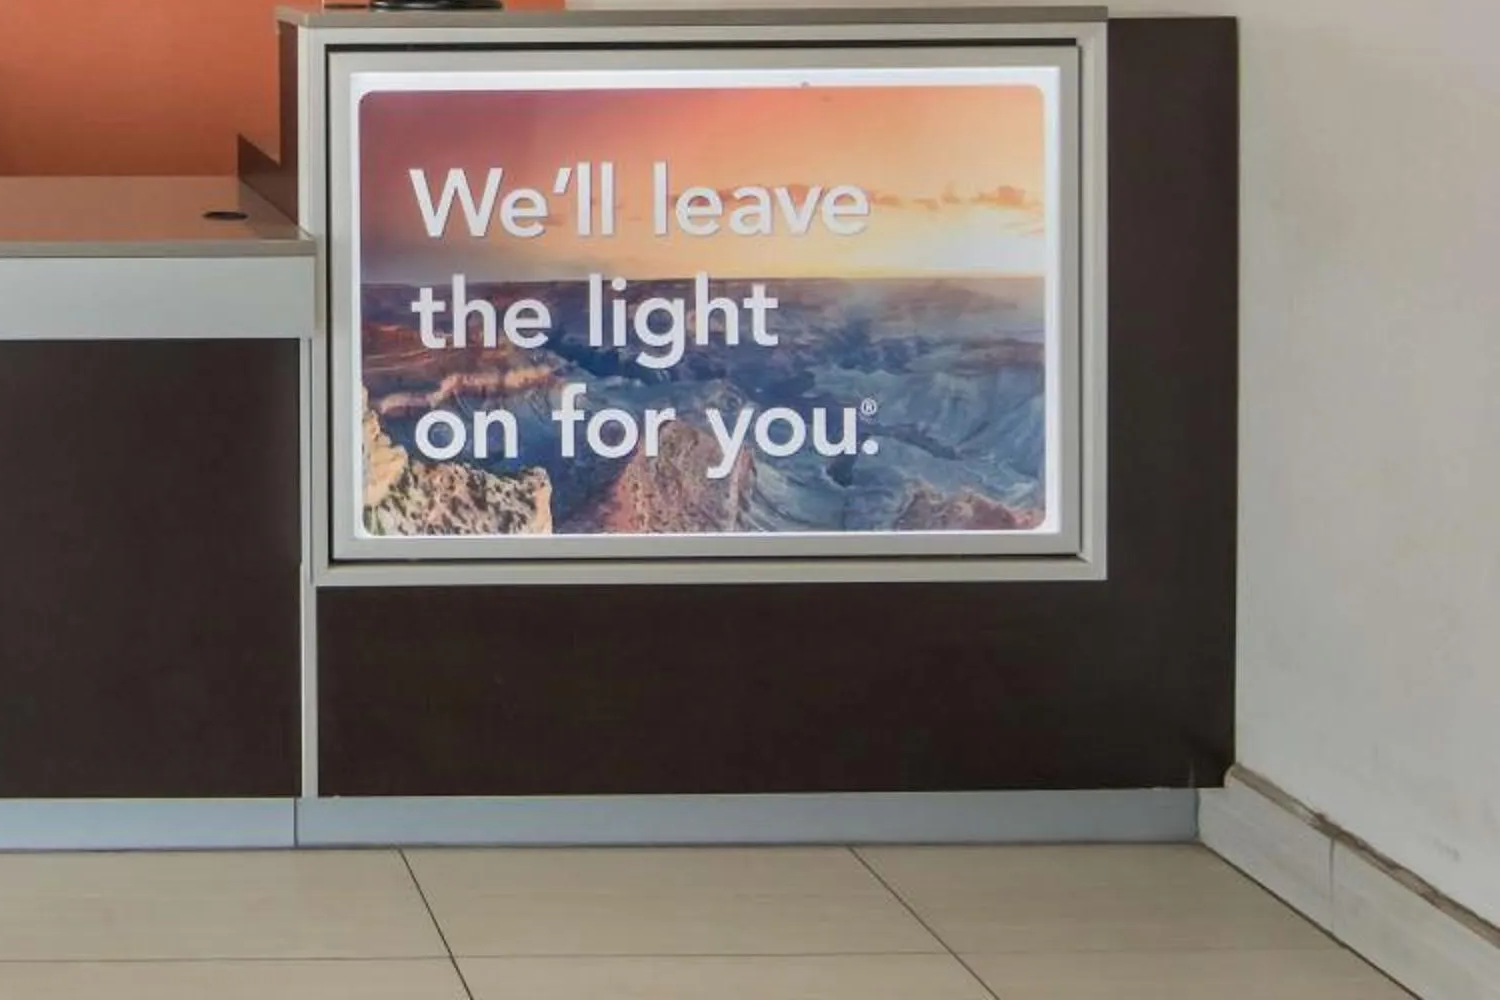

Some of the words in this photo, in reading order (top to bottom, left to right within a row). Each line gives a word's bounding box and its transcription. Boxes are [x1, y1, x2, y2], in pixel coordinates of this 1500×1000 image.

[408, 161, 614, 237] We'll
[653, 160, 870, 236] leave
[411, 273, 552, 350] the
[589, 271, 779, 369] light
[415, 406, 519, 460] on
[551, 383, 677, 459] for
